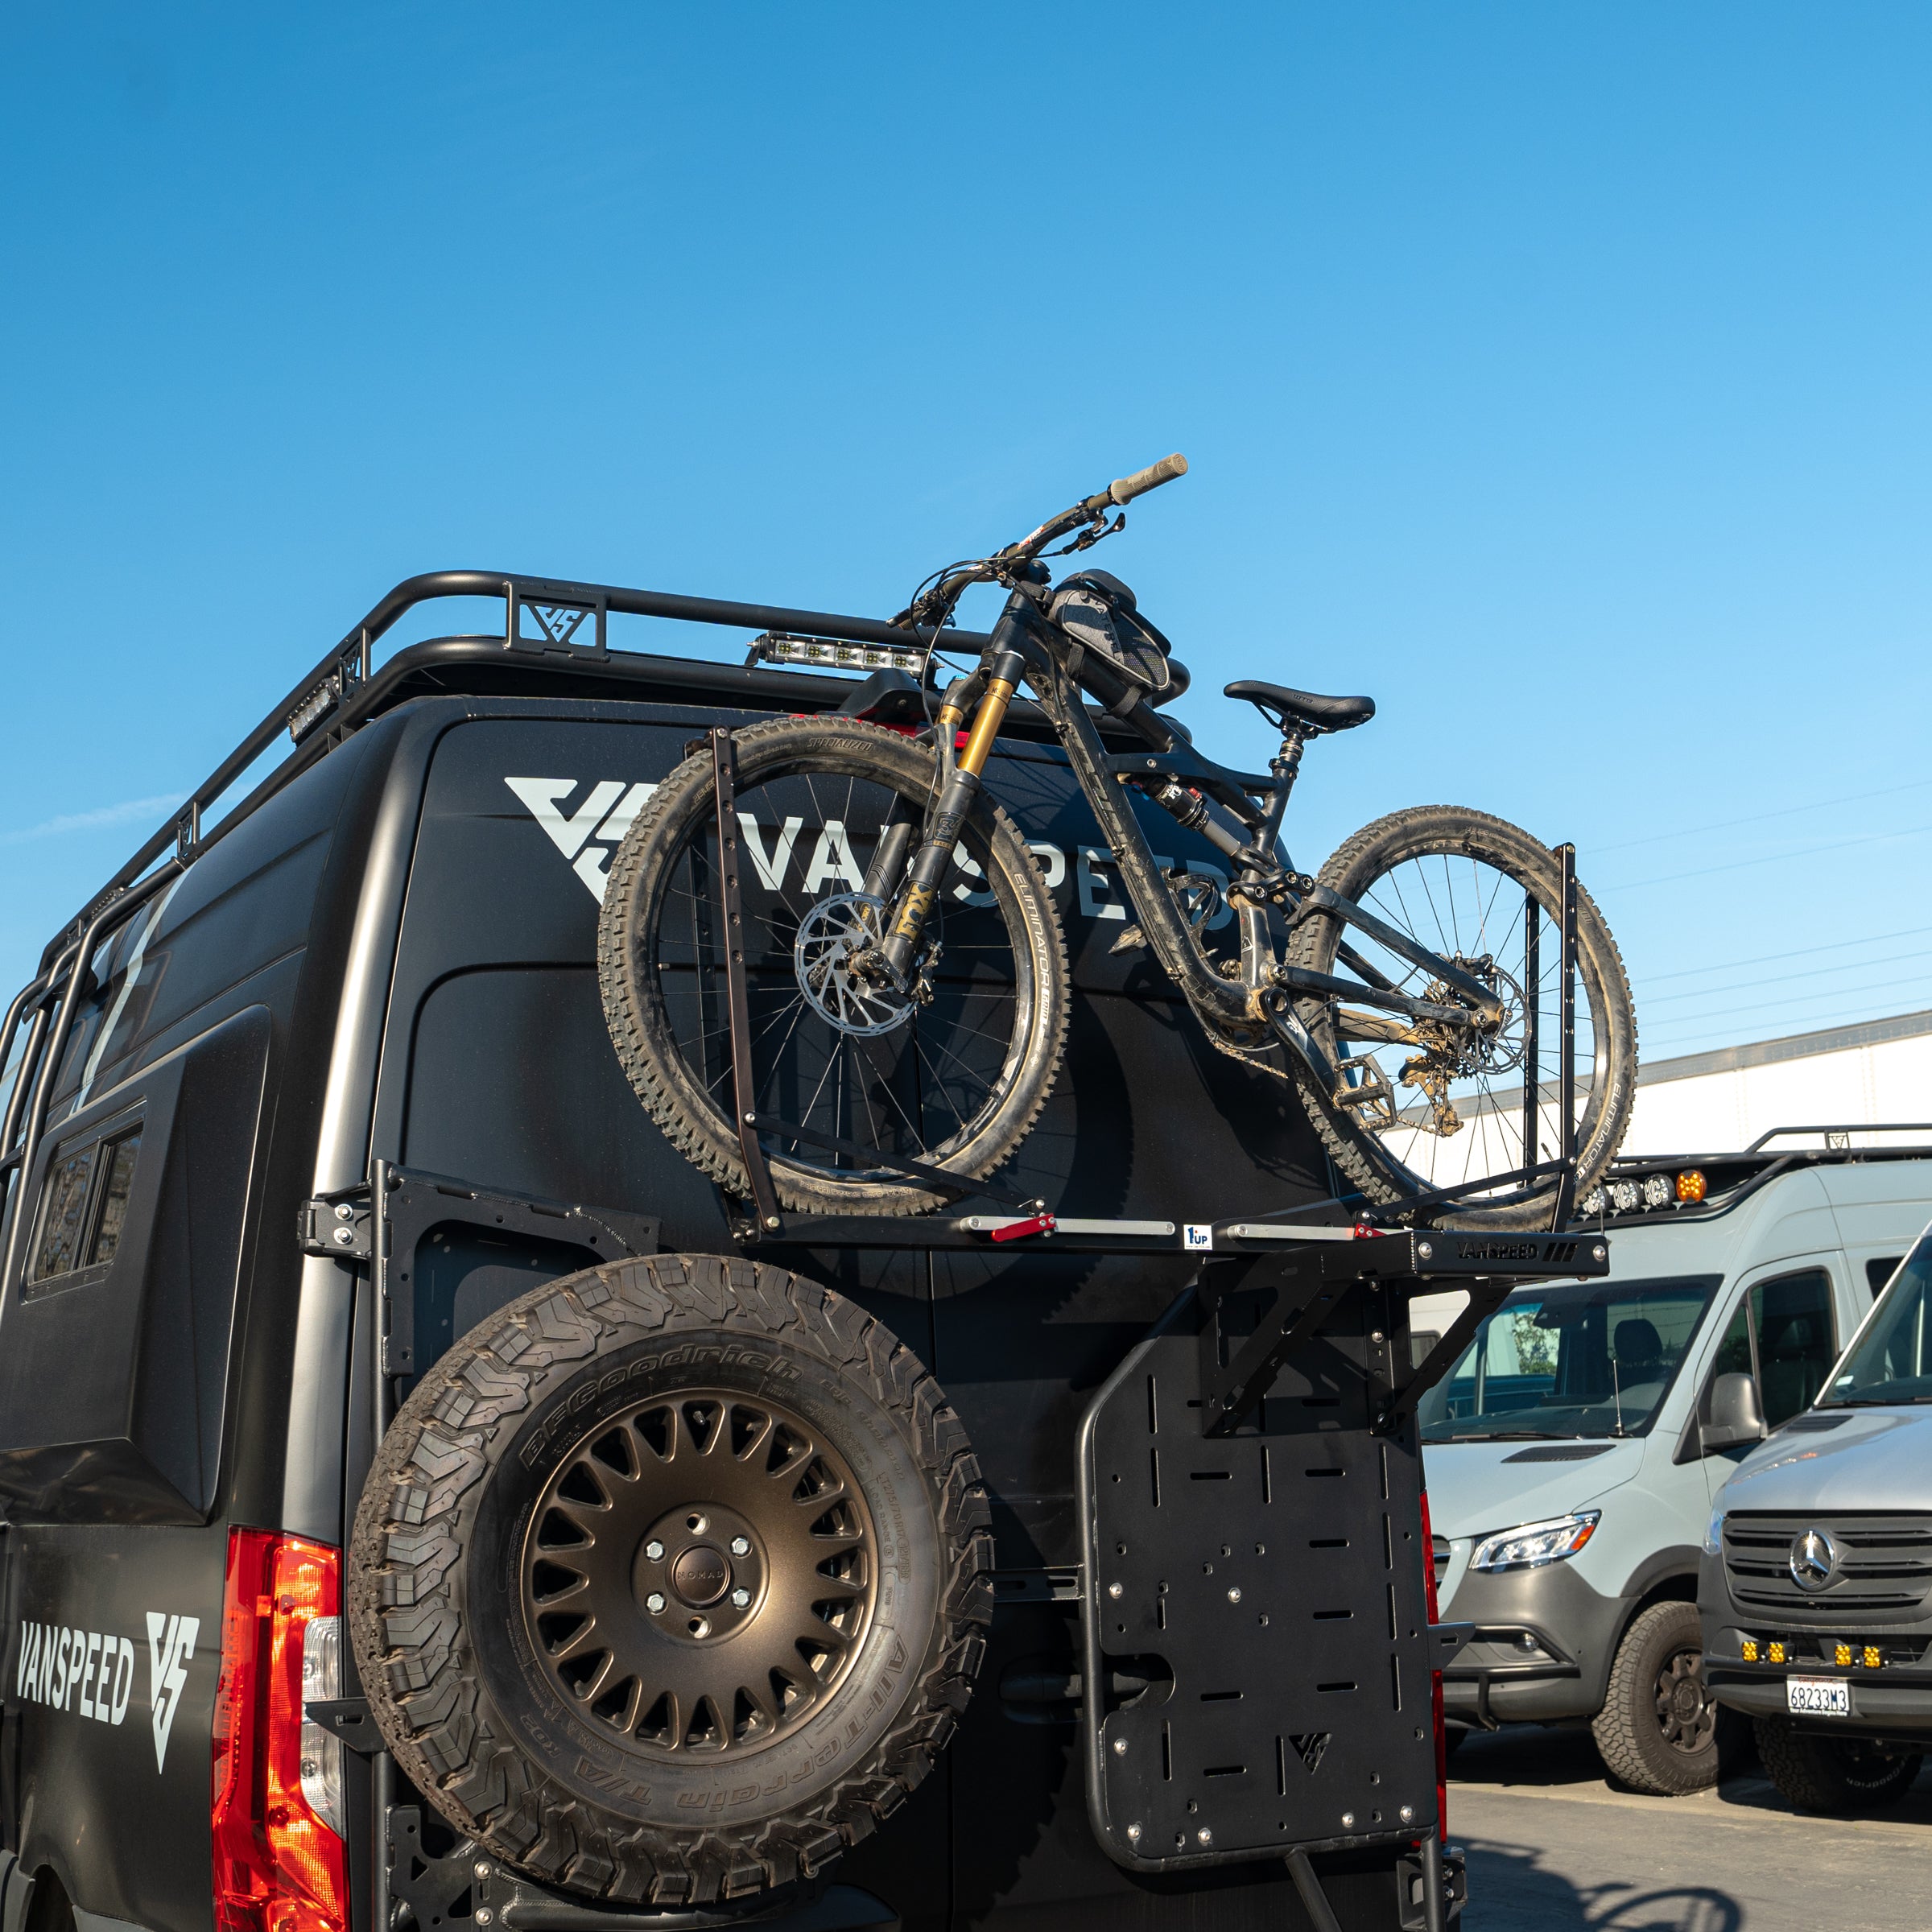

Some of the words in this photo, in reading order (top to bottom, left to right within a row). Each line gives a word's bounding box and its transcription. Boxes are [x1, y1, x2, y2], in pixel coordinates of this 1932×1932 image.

[807, 737, 875, 752] SPECIALIZED
[735, 812, 1234, 930] VASPED
[894, 882, 935, 942] FOX
[1013, 873, 1051, 987] ELIMINATOR
[1583, 1083, 1622, 1170] ELIMINATOR
[1457, 1242, 1538, 1260] VANSPEED
[519, 1344, 803, 1471] BFGoodrich
[677, 1571, 724, 1581] NOMAD
[16, 1620, 135, 1726] VANSPEED
[1791, 1686, 1847, 1711] 68233M3
